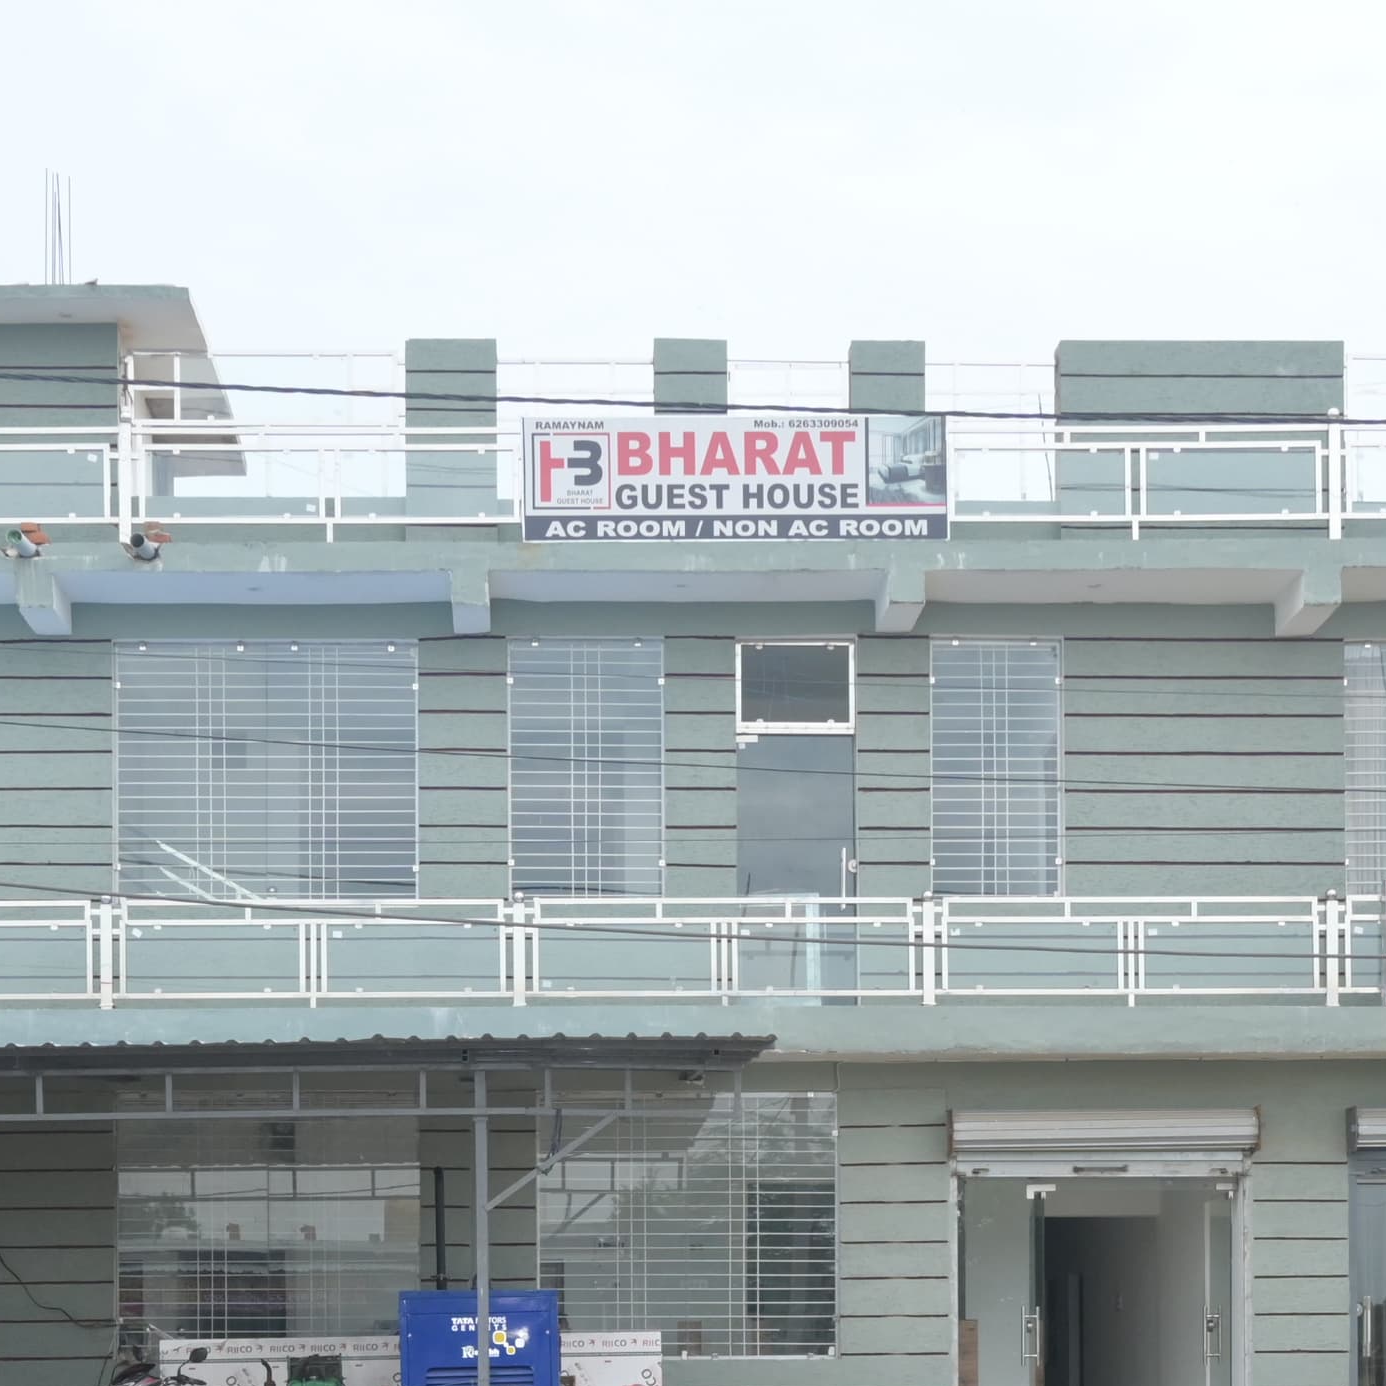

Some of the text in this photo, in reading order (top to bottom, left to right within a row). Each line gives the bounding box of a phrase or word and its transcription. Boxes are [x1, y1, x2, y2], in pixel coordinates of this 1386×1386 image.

[535, 421, 604, 430] RAMAYNAM
[753, 419, 859, 429] Mob.: 6263309054
[616, 430, 856, 477] BHARAT
[615, 482, 860, 511] GUEST HOUSE
[545, 520, 586, 537] AC
[596, 519, 686, 537] ROOM
[713, 519, 779, 537] NON
[788, 519, 829, 537] AC
[838, 518, 928, 536] ROOM
[451, 1317, 474, 1325] TATA
